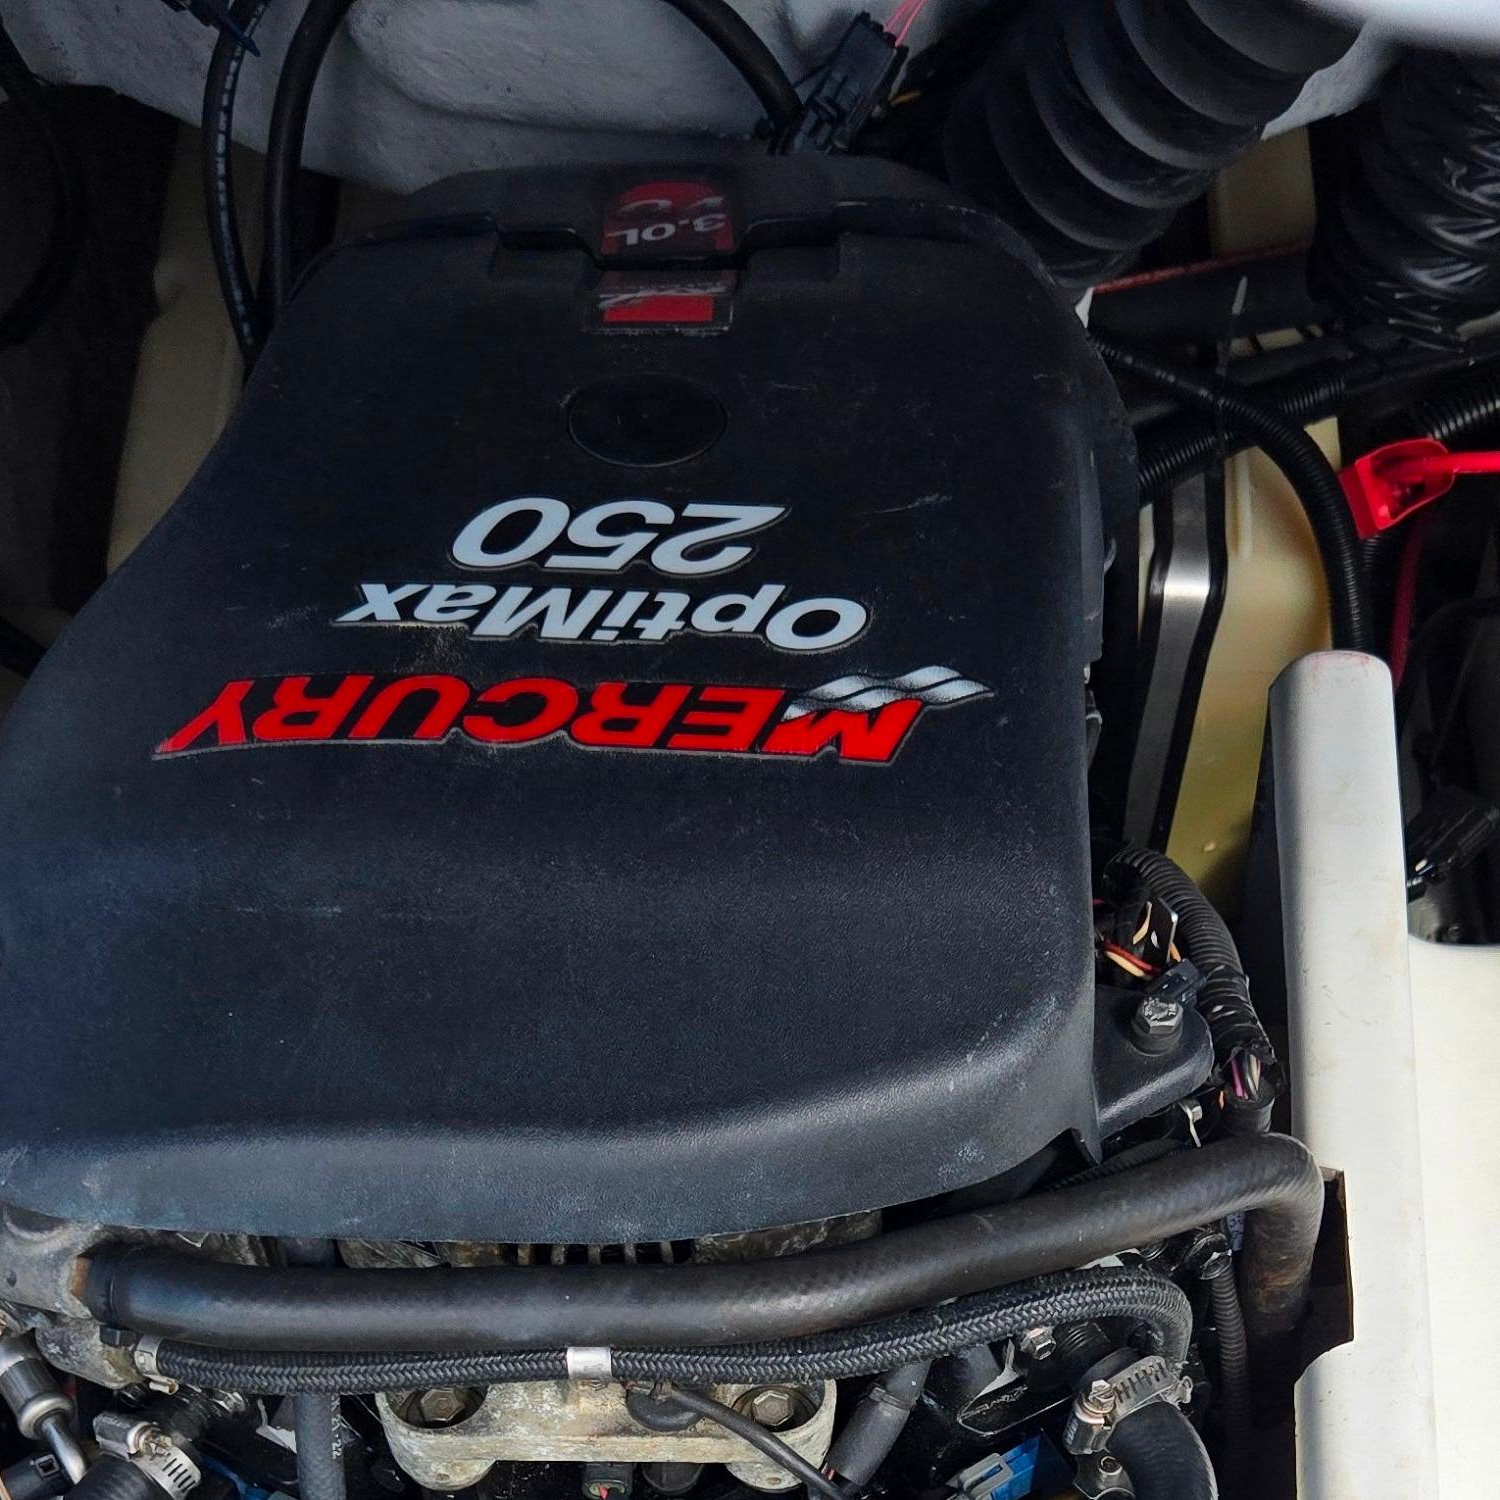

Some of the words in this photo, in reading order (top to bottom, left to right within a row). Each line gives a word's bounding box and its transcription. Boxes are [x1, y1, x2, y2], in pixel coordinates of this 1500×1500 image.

[604, 214, 727, 246] 3.0L
[452, 497, 785, 572] 250
[338, 583, 866, 650] OptiMax
[155, 673, 924, 762] MERCURY
